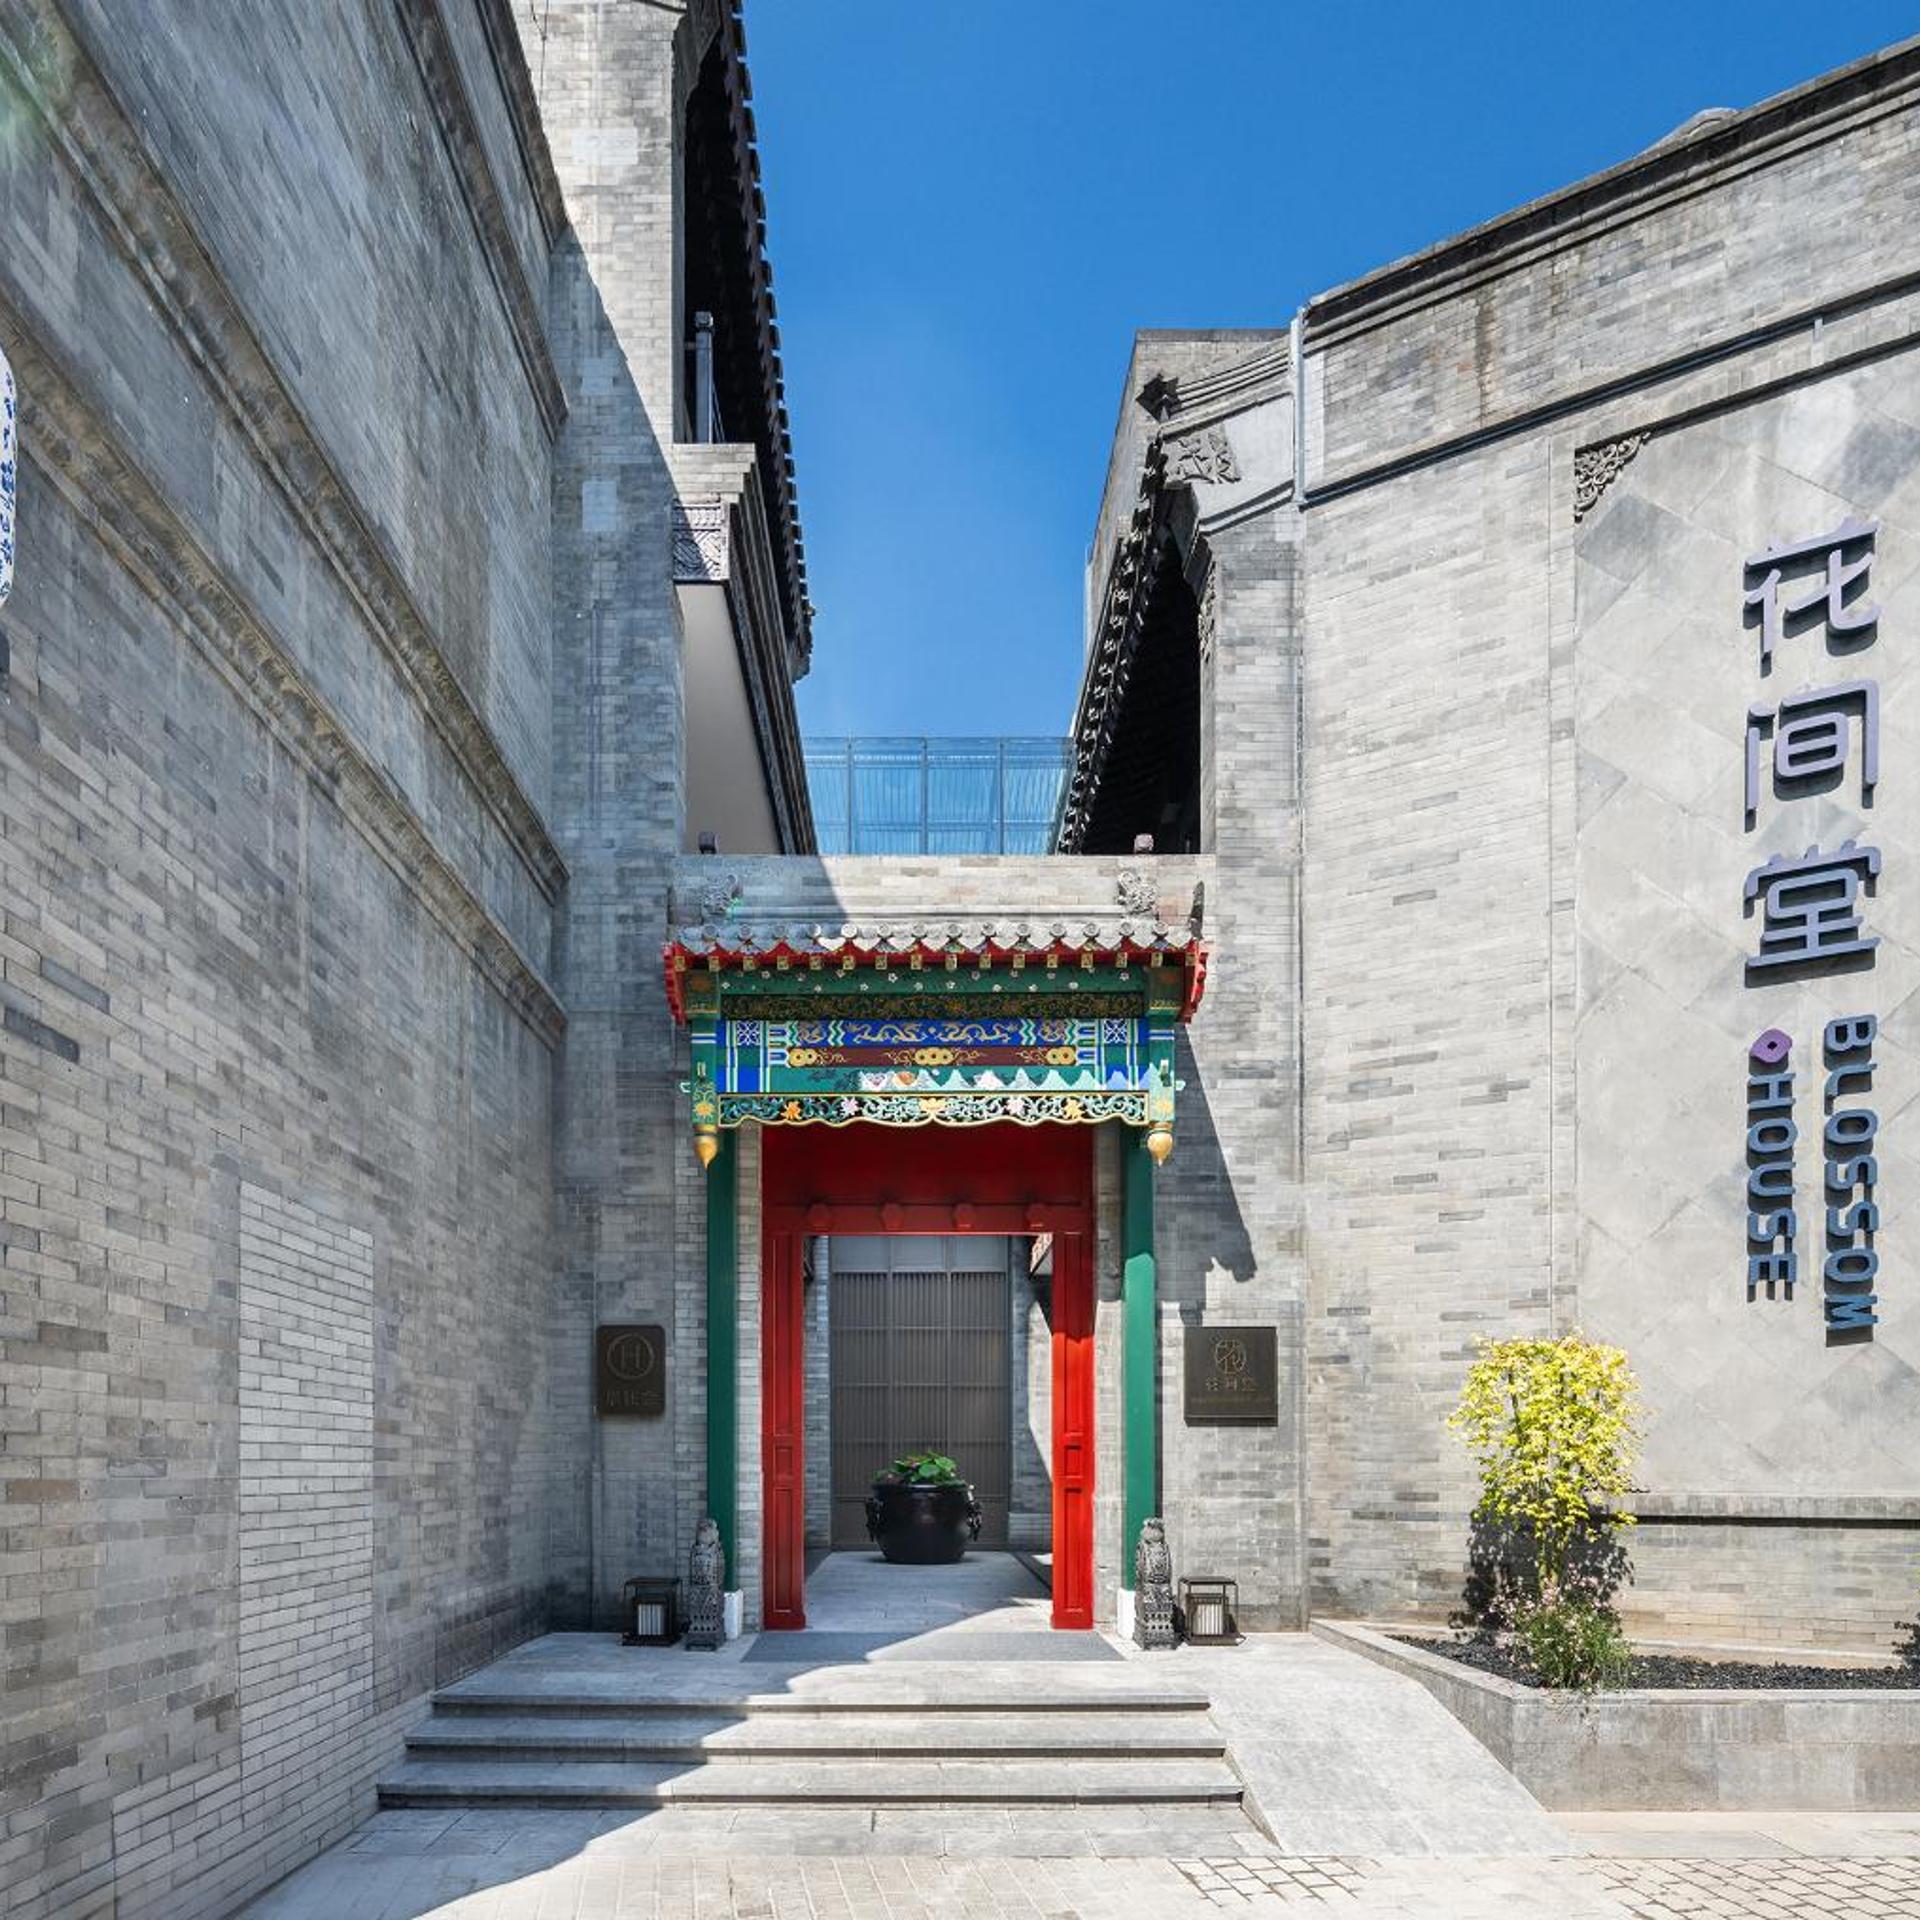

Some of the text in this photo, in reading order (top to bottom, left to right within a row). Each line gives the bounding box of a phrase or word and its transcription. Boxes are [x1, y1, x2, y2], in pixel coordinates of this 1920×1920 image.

[1744, 516, 1881, 970] 花间堂
[1747, 1073, 1798, 1286] HOUSE
[1824, 1014, 1878, 1331] BLOSSOM
